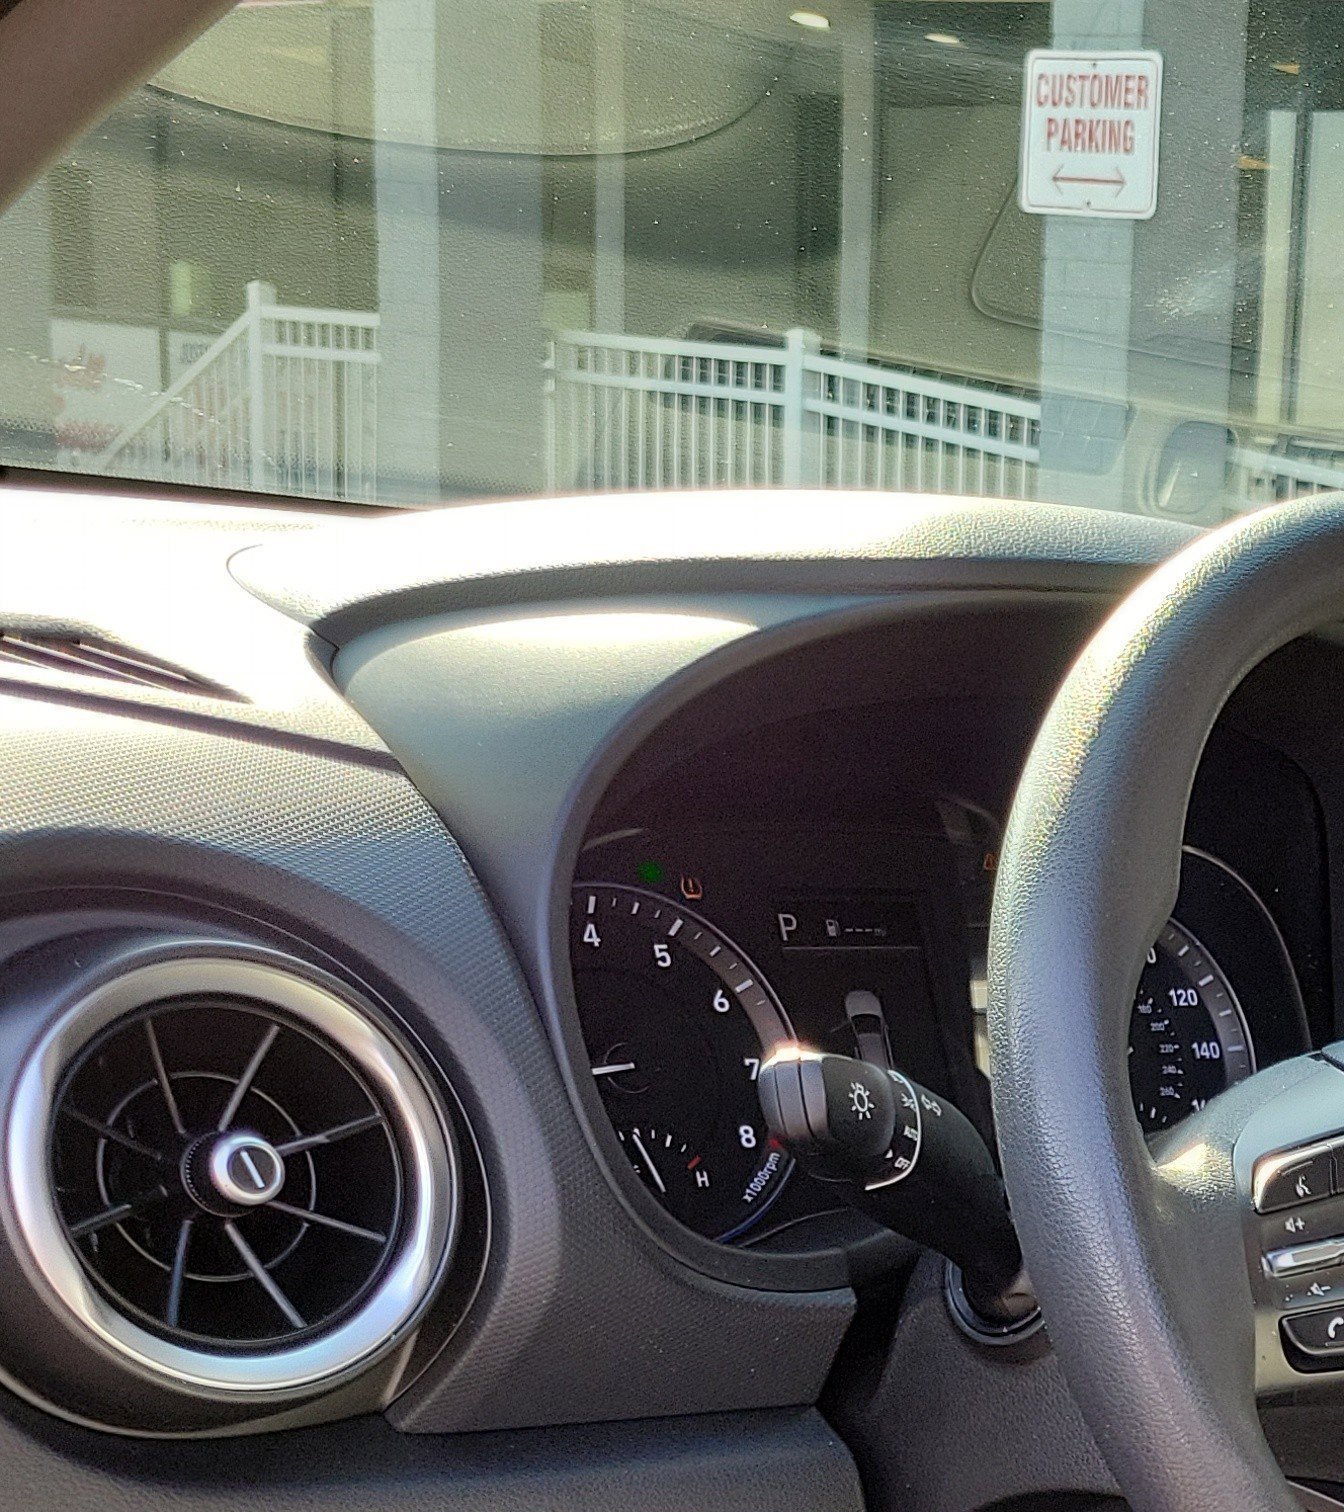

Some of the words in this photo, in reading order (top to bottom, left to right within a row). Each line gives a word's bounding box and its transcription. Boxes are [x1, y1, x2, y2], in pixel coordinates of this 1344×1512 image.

[1036, 73, 1150, 110] CUSTOMER
[1046, 117, 1135, 155] PARKING
[583, 923, 602, 947] 4
[778, 913, 797, 941] P
[653, 944, 672, 967] 5
[713, 989, 730, 1013] 6
[1168, 987, 1198, 1007] 120
[1191, 1041, 1220, 1060] 140
[744, 1058, 760, 1081] 7
[739, 1125, 757, 1149] 8
[695, 1170, 710, 1188] H
